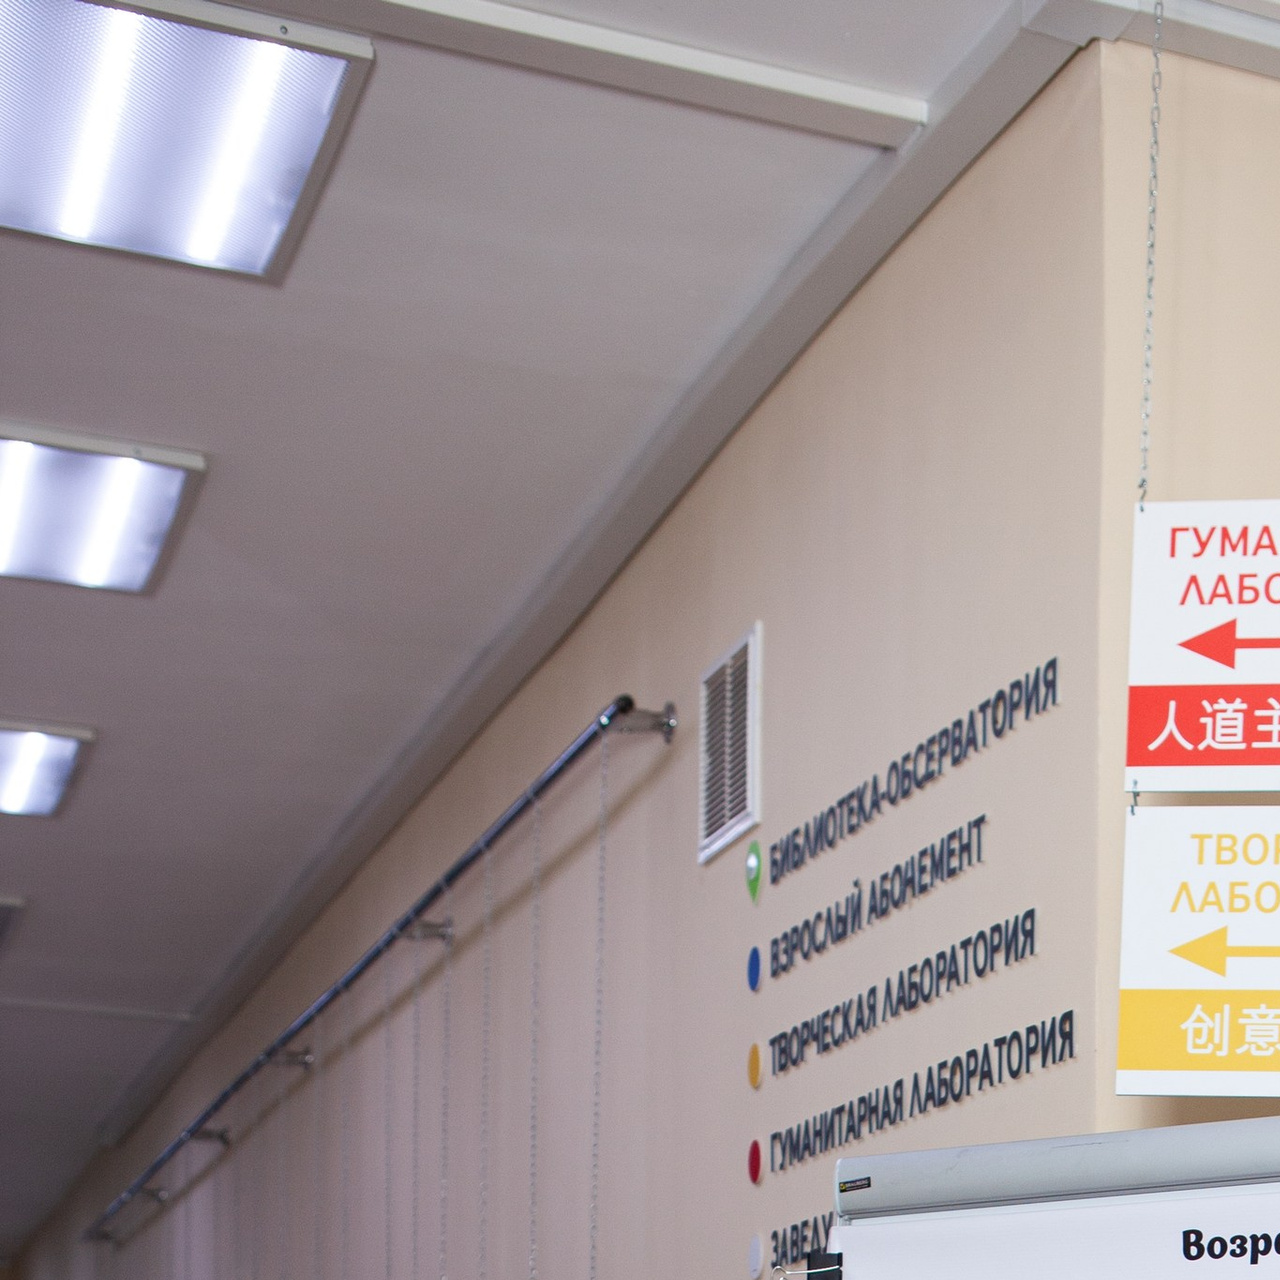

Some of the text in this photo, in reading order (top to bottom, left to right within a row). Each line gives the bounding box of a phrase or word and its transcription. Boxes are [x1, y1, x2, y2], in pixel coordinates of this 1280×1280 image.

[769, 656, 1060, 886] БИБЛИОТЕКА-ОБСЕРВАТОРИЯ
[769, 814, 988, 979] ВЗРОСЛЫЙ АБОНЕМЕНТ
[769, 908, 1038, 1077] ТВОРЧЕСКАЯ ЛАБОРАТОРИЯ
[769, 1009, 1076, 1172] ГУМАНИТАРНАЯ ЛАБОРАТОРИЯ
[771, 1211, 833, 1269] ЗАВЕДУ
